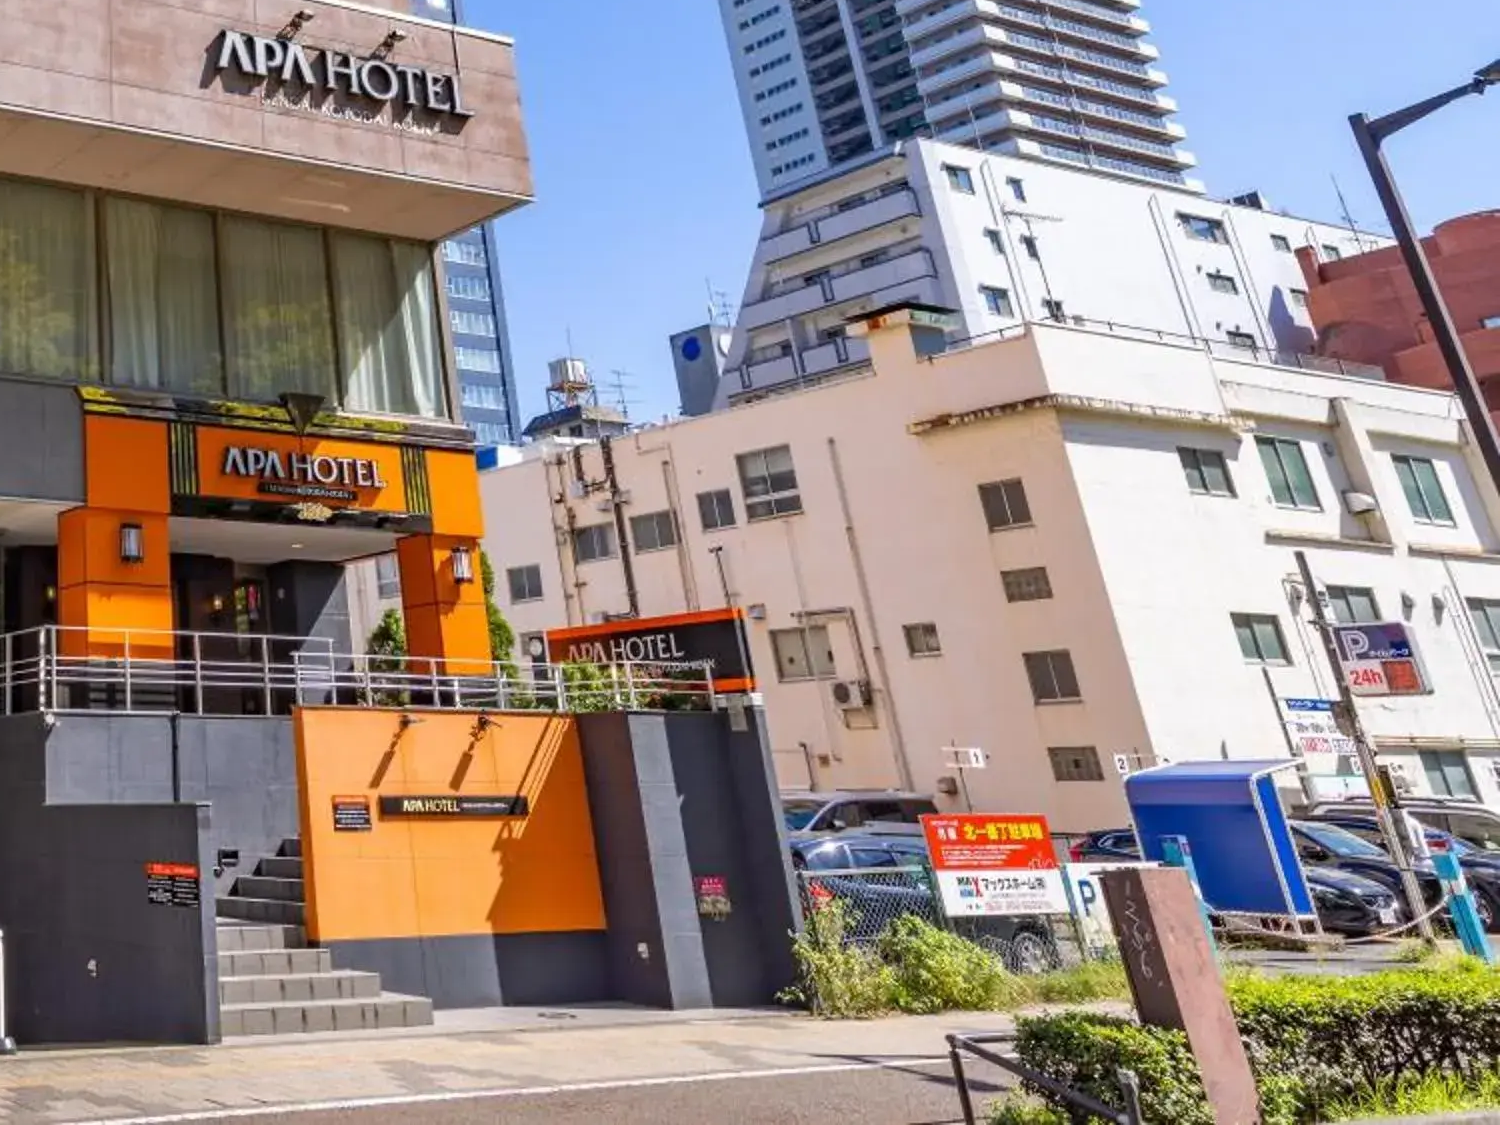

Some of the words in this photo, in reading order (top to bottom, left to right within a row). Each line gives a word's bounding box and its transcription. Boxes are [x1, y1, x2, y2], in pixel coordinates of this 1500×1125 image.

[218, 30, 317, 85] APA
[325, 49, 476, 117] HOTEL
[224, 446, 286, 478] APA
[290, 452, 388, 488] HOTEL
[568, 641, 608, 663] APA
[609, 632, 685, 663] HOTEL
[1339, 629, 1370, 662] P
[1348, 668, 1383, 686] 24h
[402, 799, 425, 812] APA
[425, 799, 461, 813] HOTEL
[1077, 878, 1097, 917] P
